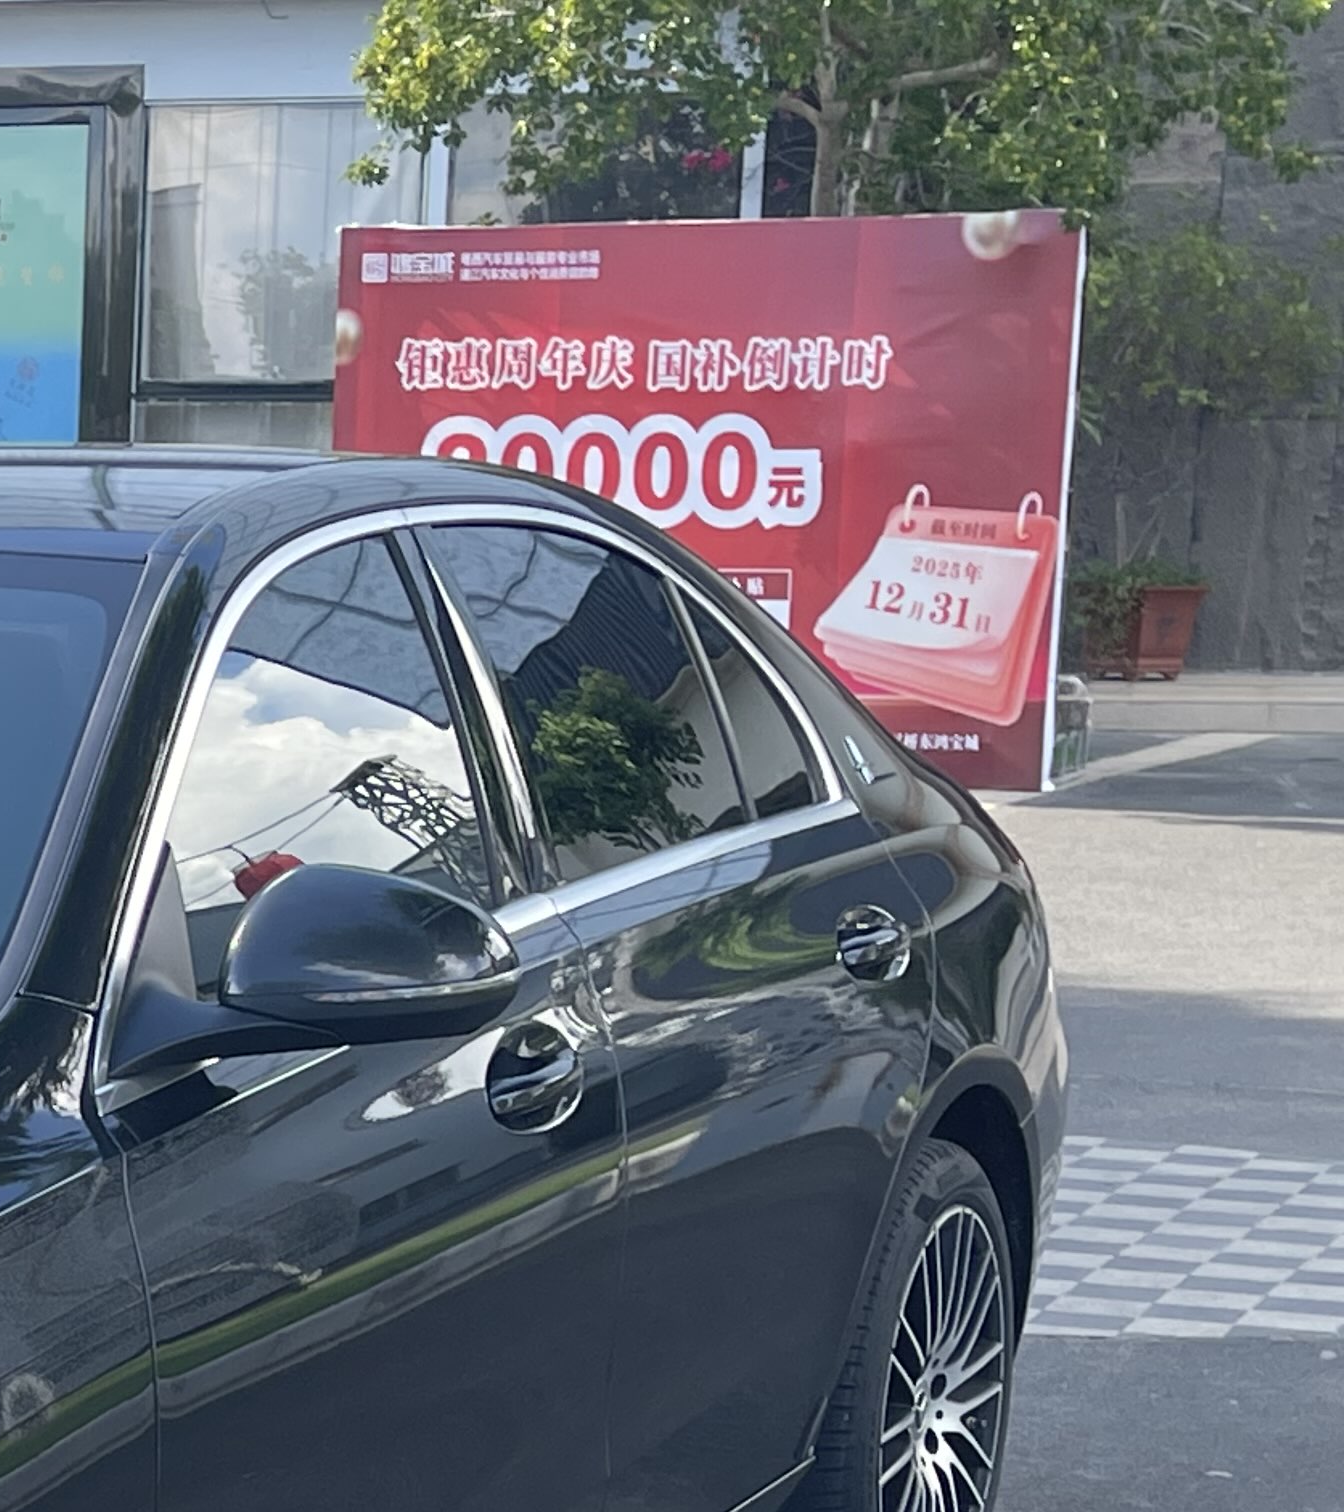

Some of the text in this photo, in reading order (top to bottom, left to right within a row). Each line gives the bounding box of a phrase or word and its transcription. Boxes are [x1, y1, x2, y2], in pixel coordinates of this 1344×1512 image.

[396, 335, 894, 392] 钜惠周年庆 国补倒计时
[910, 555, 985, 585] 2025年
[864, 580, 992, 634] 12月31日
